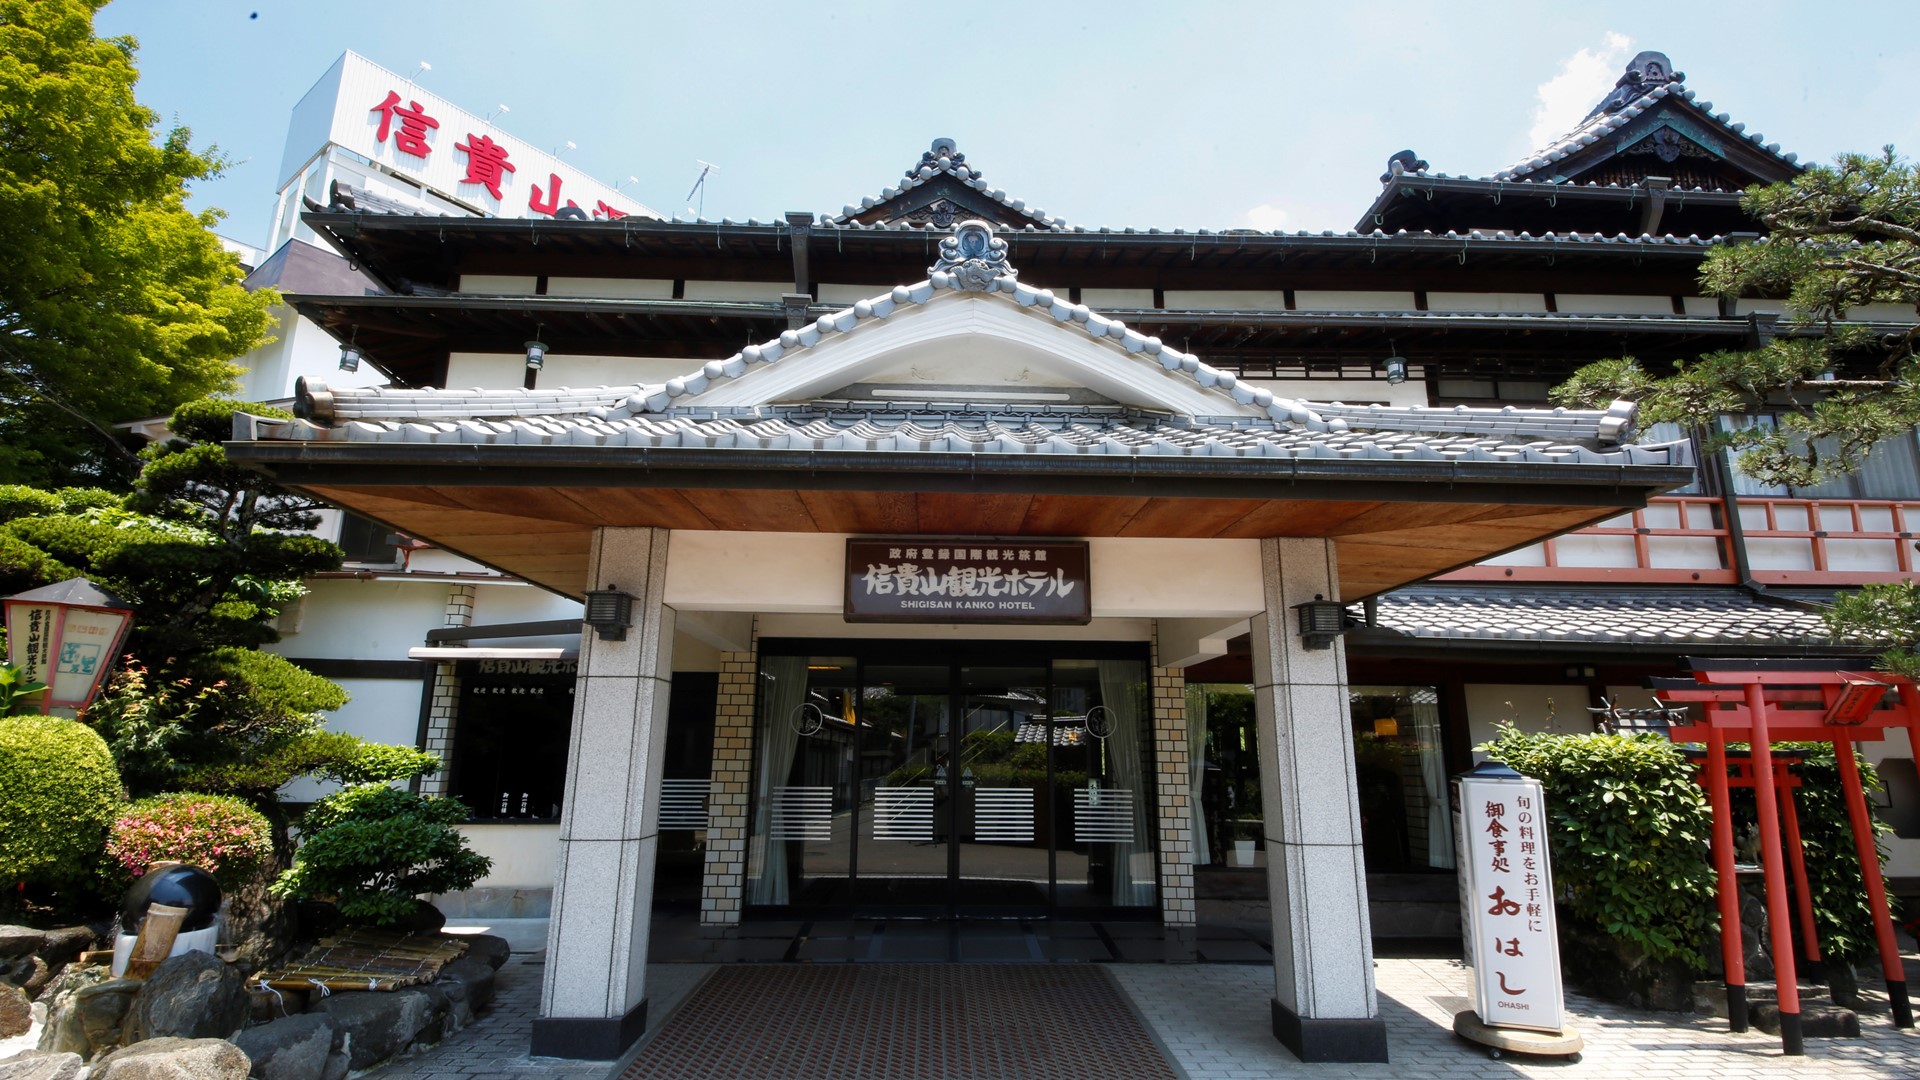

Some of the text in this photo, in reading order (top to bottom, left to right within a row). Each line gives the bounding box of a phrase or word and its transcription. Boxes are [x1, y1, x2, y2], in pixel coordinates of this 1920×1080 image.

[889, 548, 1047, 561] 政府登録国際観光旅館
[861, 563, 1075, 598] 信貴山観光ホテル
[900, 600, 1036, 610] SHIGISAN KANKO HOTEL
[25, 609, 43, 684] 信貴山観光ホテ
[1516, 796, 1542, 932] 旬の料理をお手軽に
[1485, 801, 1527, 996] 御食事処 おはし
[1497, 1001, 1530, 1011] OHASHI
